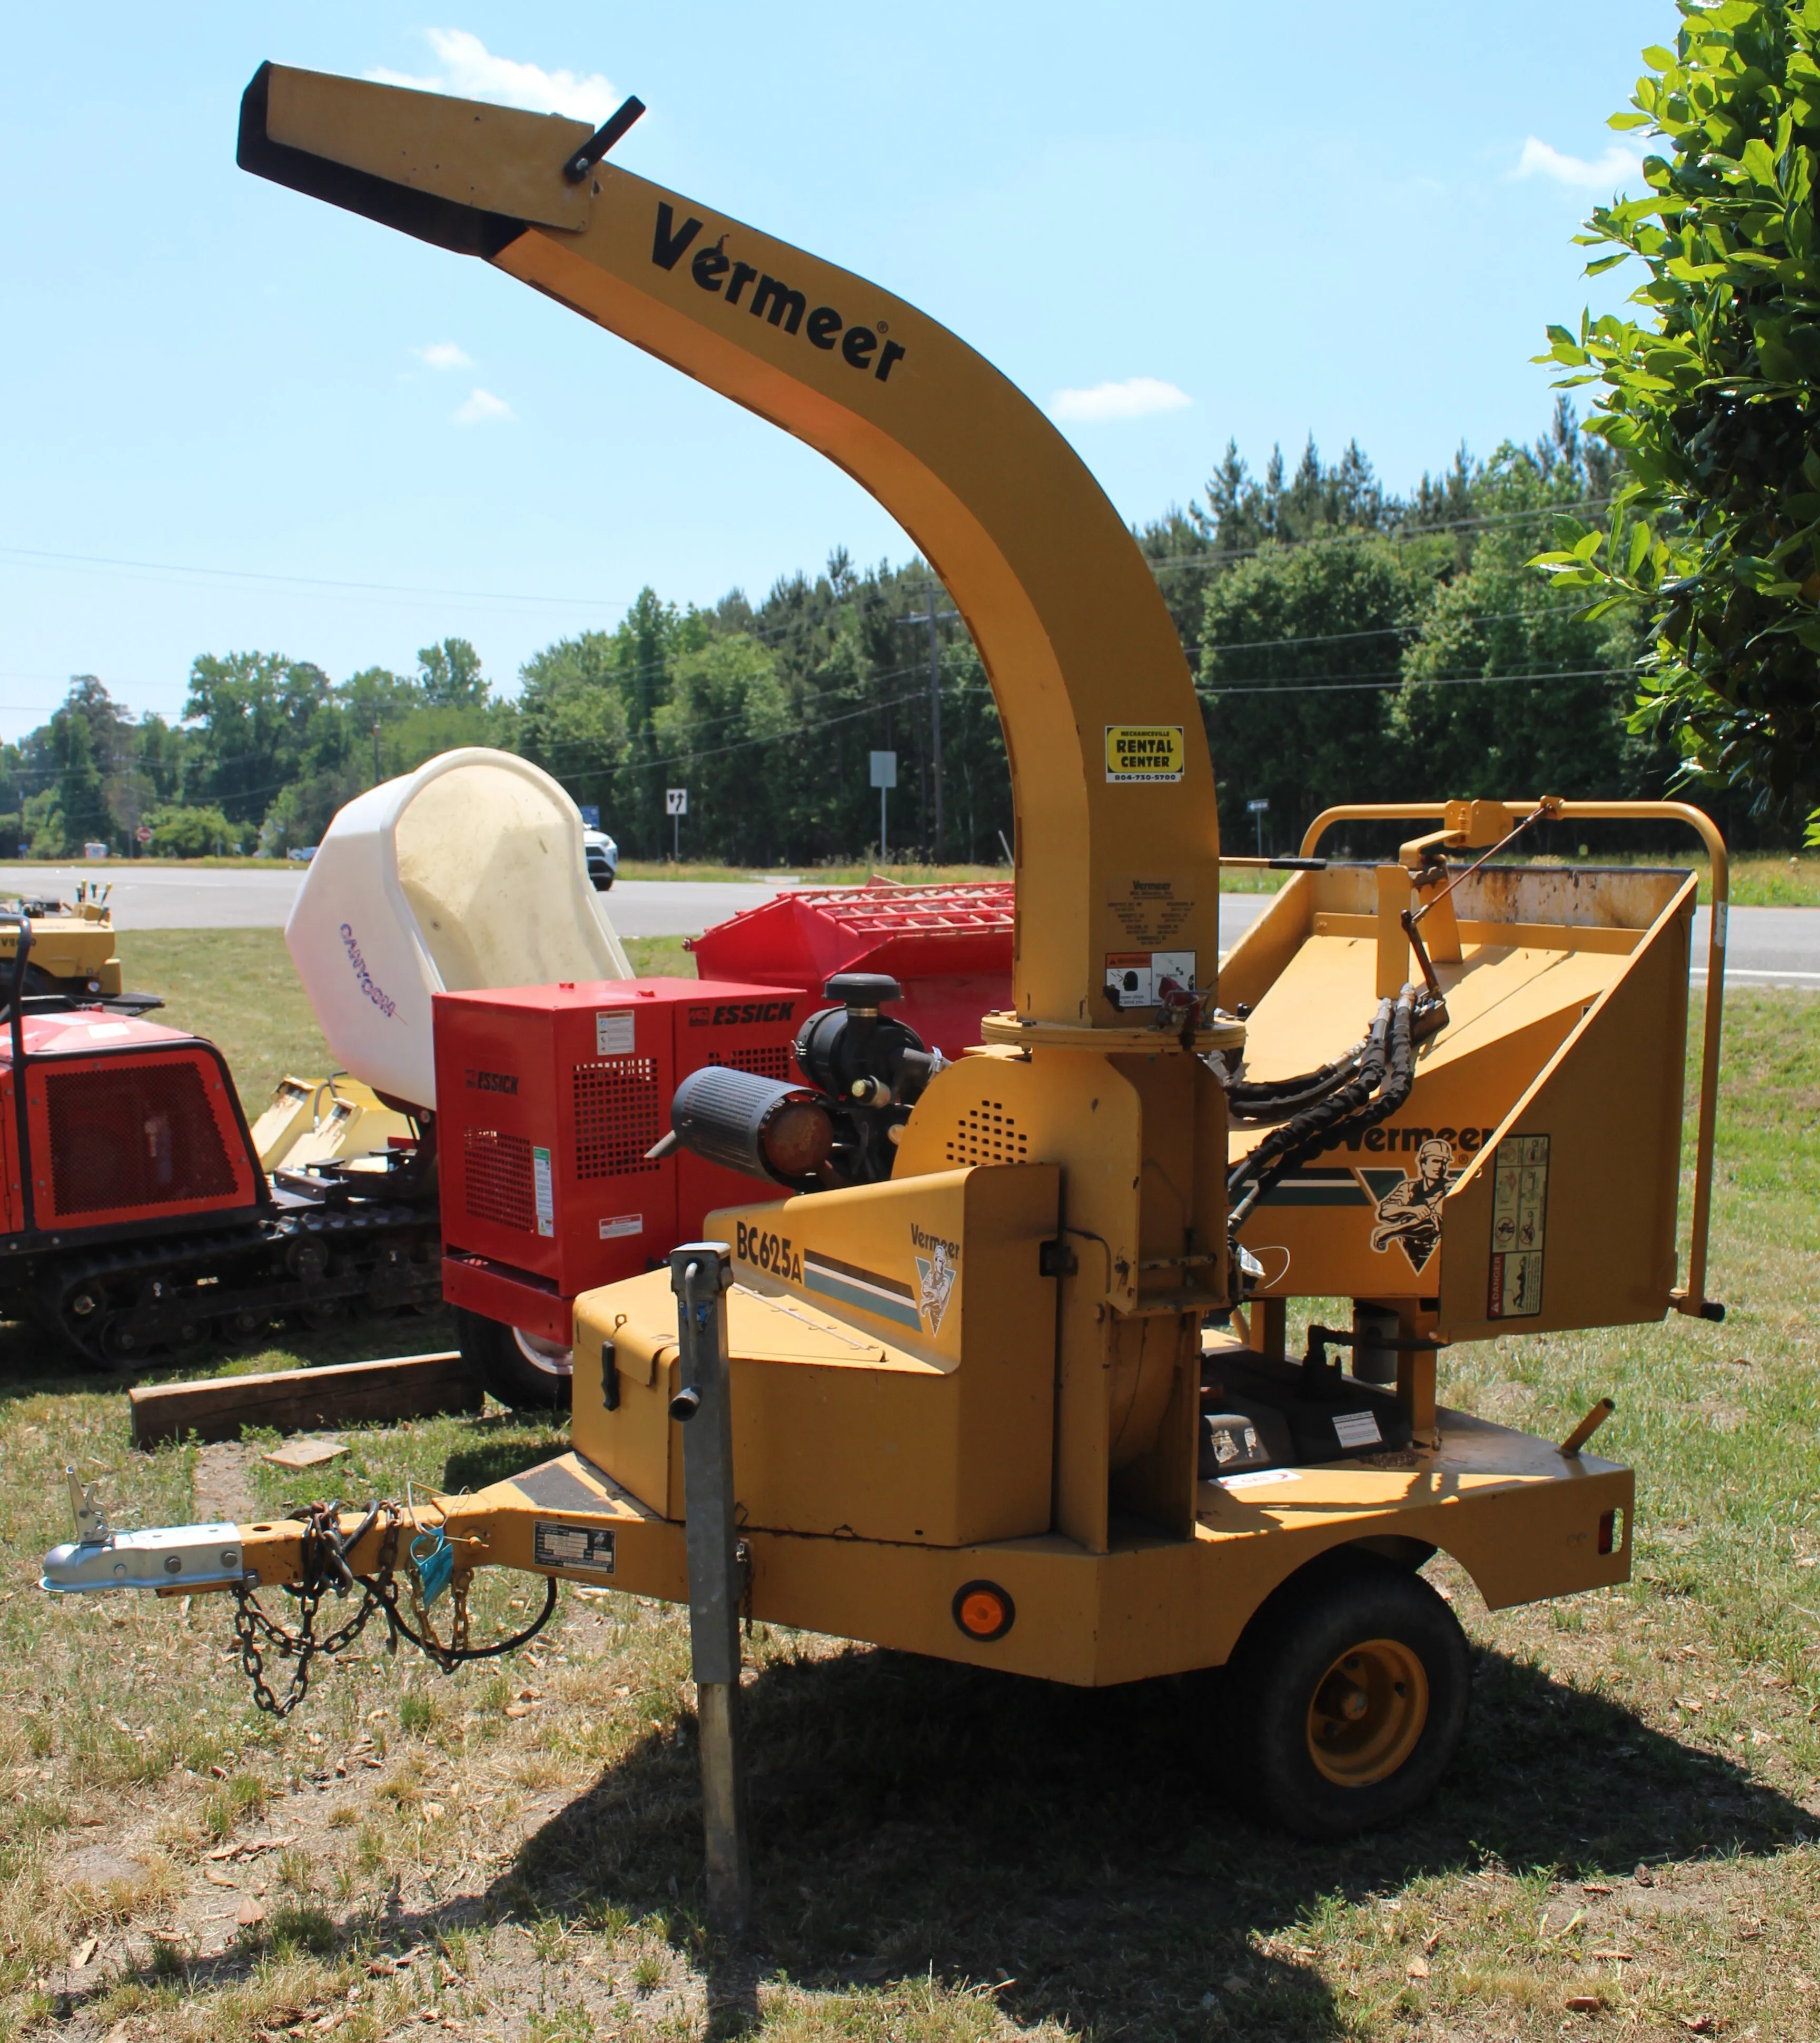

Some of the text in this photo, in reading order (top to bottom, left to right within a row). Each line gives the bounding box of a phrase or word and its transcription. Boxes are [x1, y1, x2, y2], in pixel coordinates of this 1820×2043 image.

[652, 201, 906, 382] Vermeer
[1116, 739, 1174, 753] RENTAL
[1121, 756, 1170, 767] CENTER
[713, 1002, 795, 1026] ESSICK
[478, 1070, 519, 1095] ESSICK
[737, 1221, 802, 1284] BC625A
[1492, 1257, 1501, 1300] DANGER
